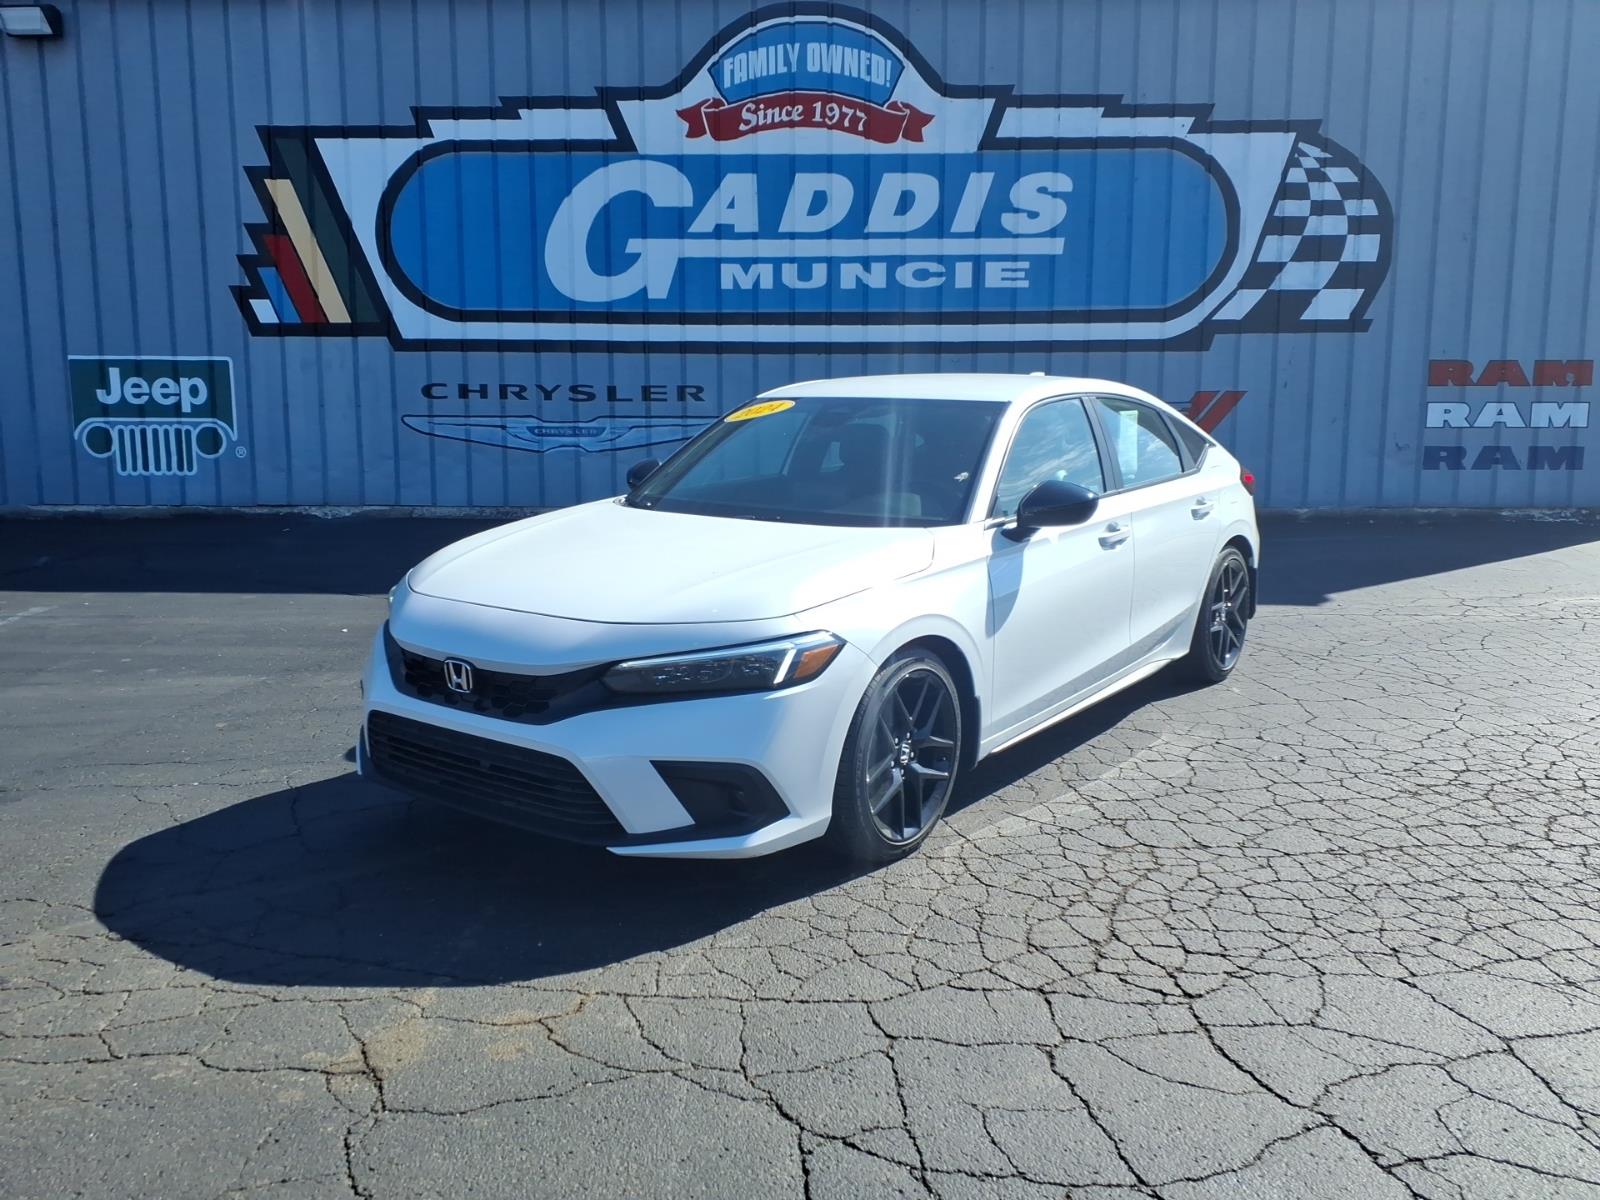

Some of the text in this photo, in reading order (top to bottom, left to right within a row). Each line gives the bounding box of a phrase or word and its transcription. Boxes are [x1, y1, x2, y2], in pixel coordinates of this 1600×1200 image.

[723, 42, 892, 88] FAMILY OWNED!
[738, 101, 868, 131] Since 1977
[544, 159, 1074, 303] GADDIS
[720, 261, 1030, 290] MUNCIE
[1428, 359, 1594, 387] RAM
[96, 367, 208, 413] Jeep
[420, 383, 706, 402] CHRYSLER
[1425, 401, 1590, 428] RAM
[533, 427, 598, 436] CHRYSLER
[1422, 445, 1585, 471] RAM
